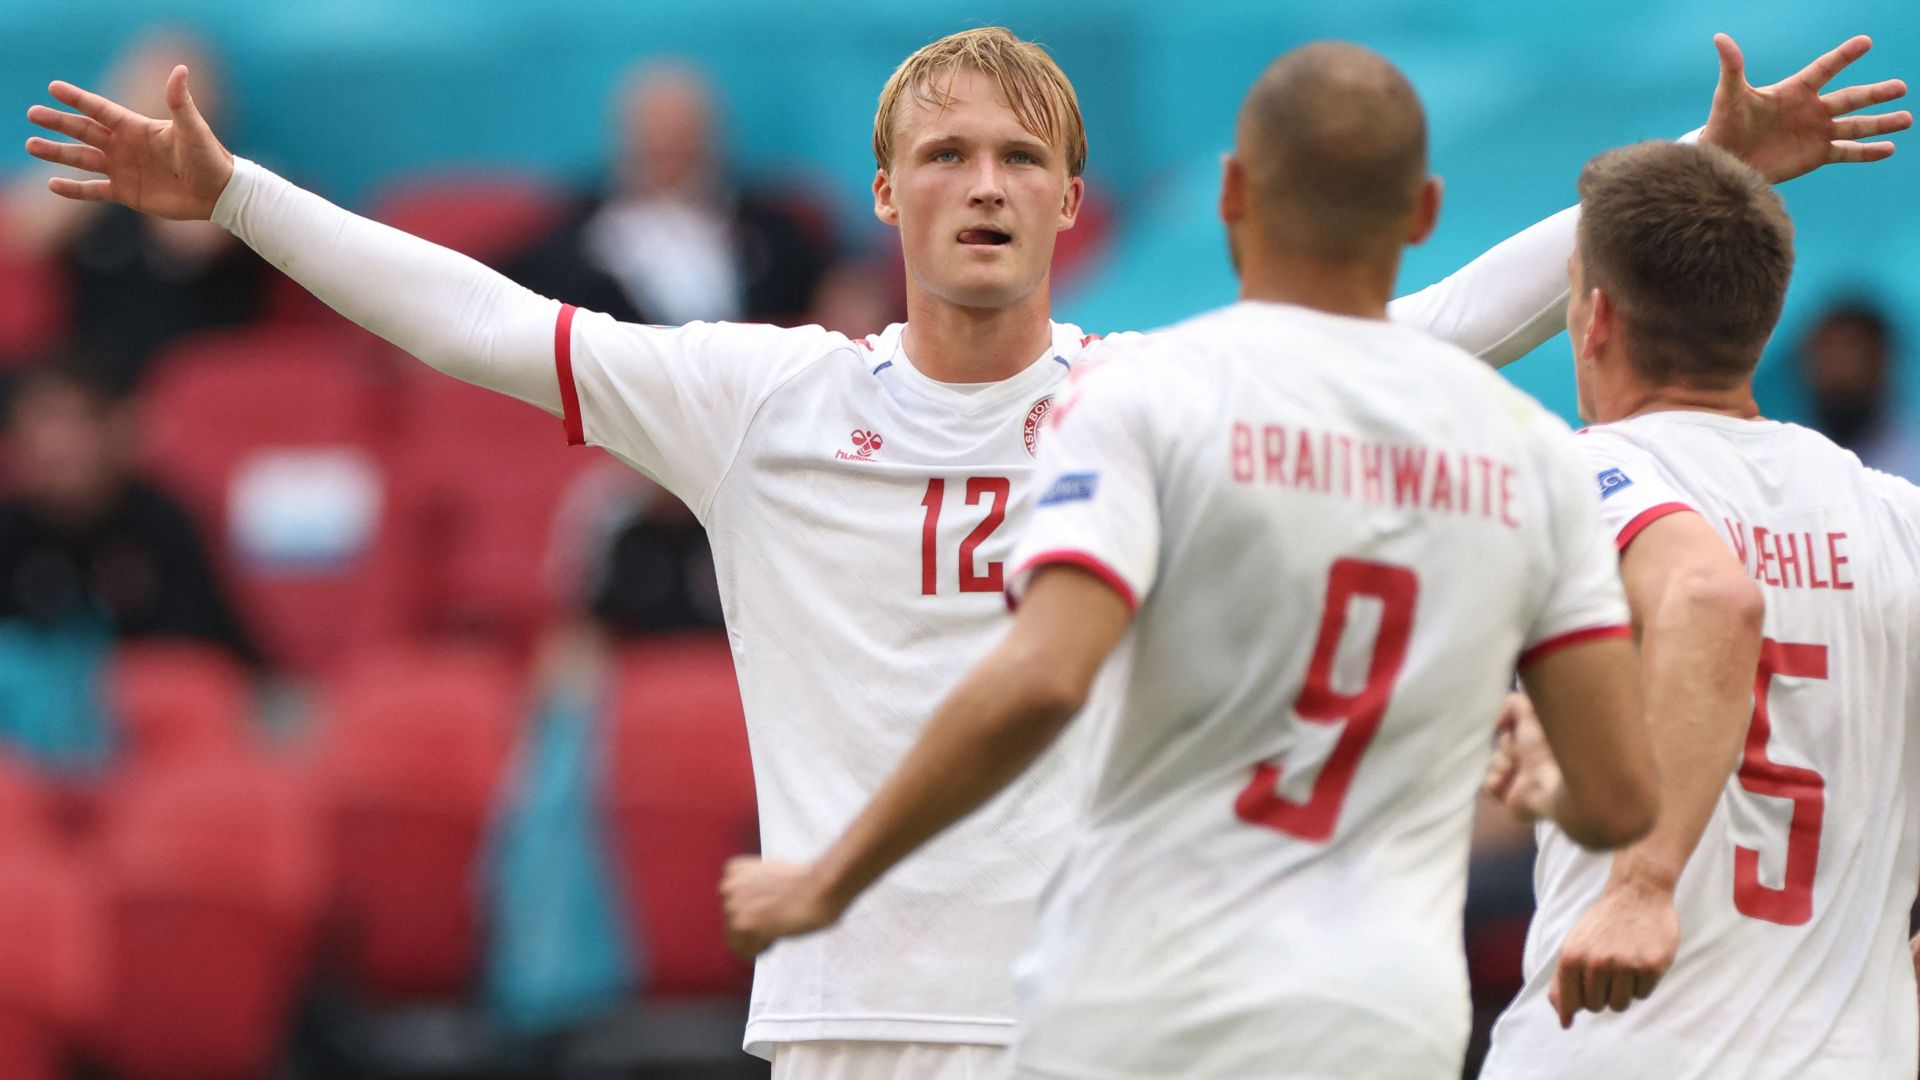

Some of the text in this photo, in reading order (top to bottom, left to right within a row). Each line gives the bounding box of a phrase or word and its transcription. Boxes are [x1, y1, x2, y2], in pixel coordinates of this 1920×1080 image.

[920, 476, 1010, 595] 12
[1231, 421, 1519, 528] BRAITHWAITE
[1233, 556, 1419, 843] 9
[1732, 637, 1828, 926] 5
